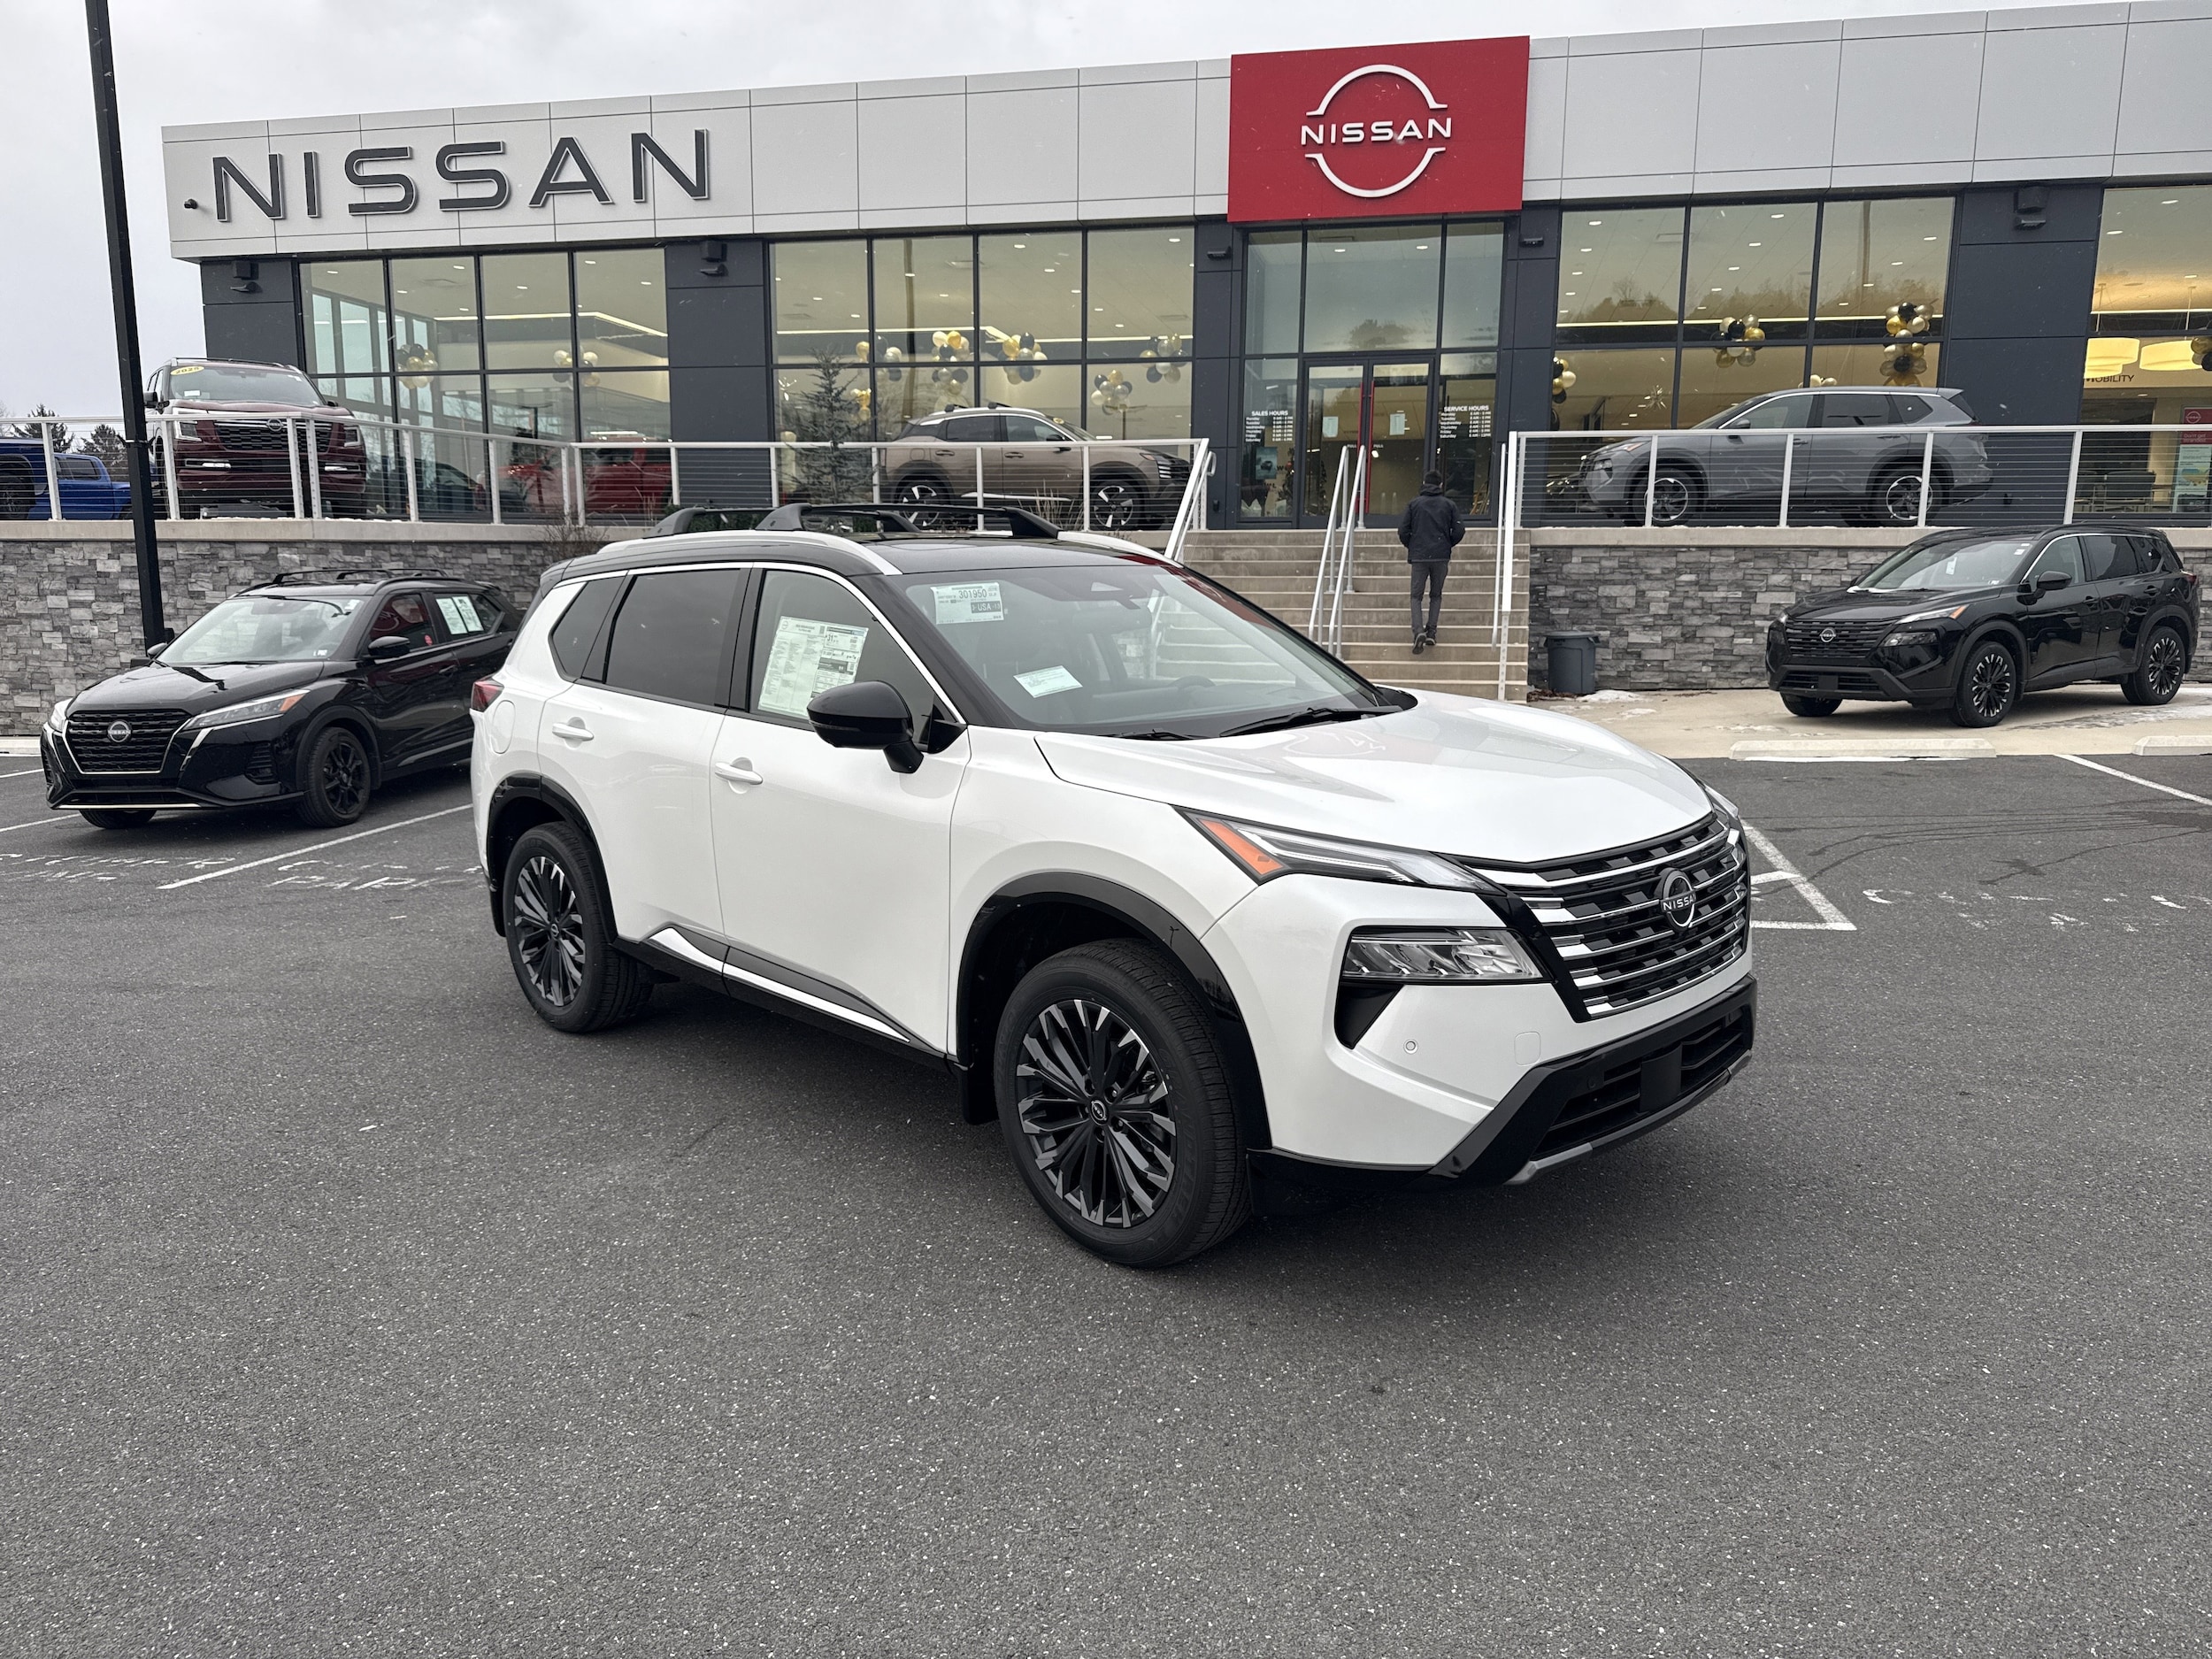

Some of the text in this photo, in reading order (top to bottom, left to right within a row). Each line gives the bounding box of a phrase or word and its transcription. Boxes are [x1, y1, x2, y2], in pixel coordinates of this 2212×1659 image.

[1301, 118, 1451, 145] NISSAN
[212, 129, 709, 223] NISSAN
[958, 588, 987, 599] 301950
[977, 603, 992, 611] USA
